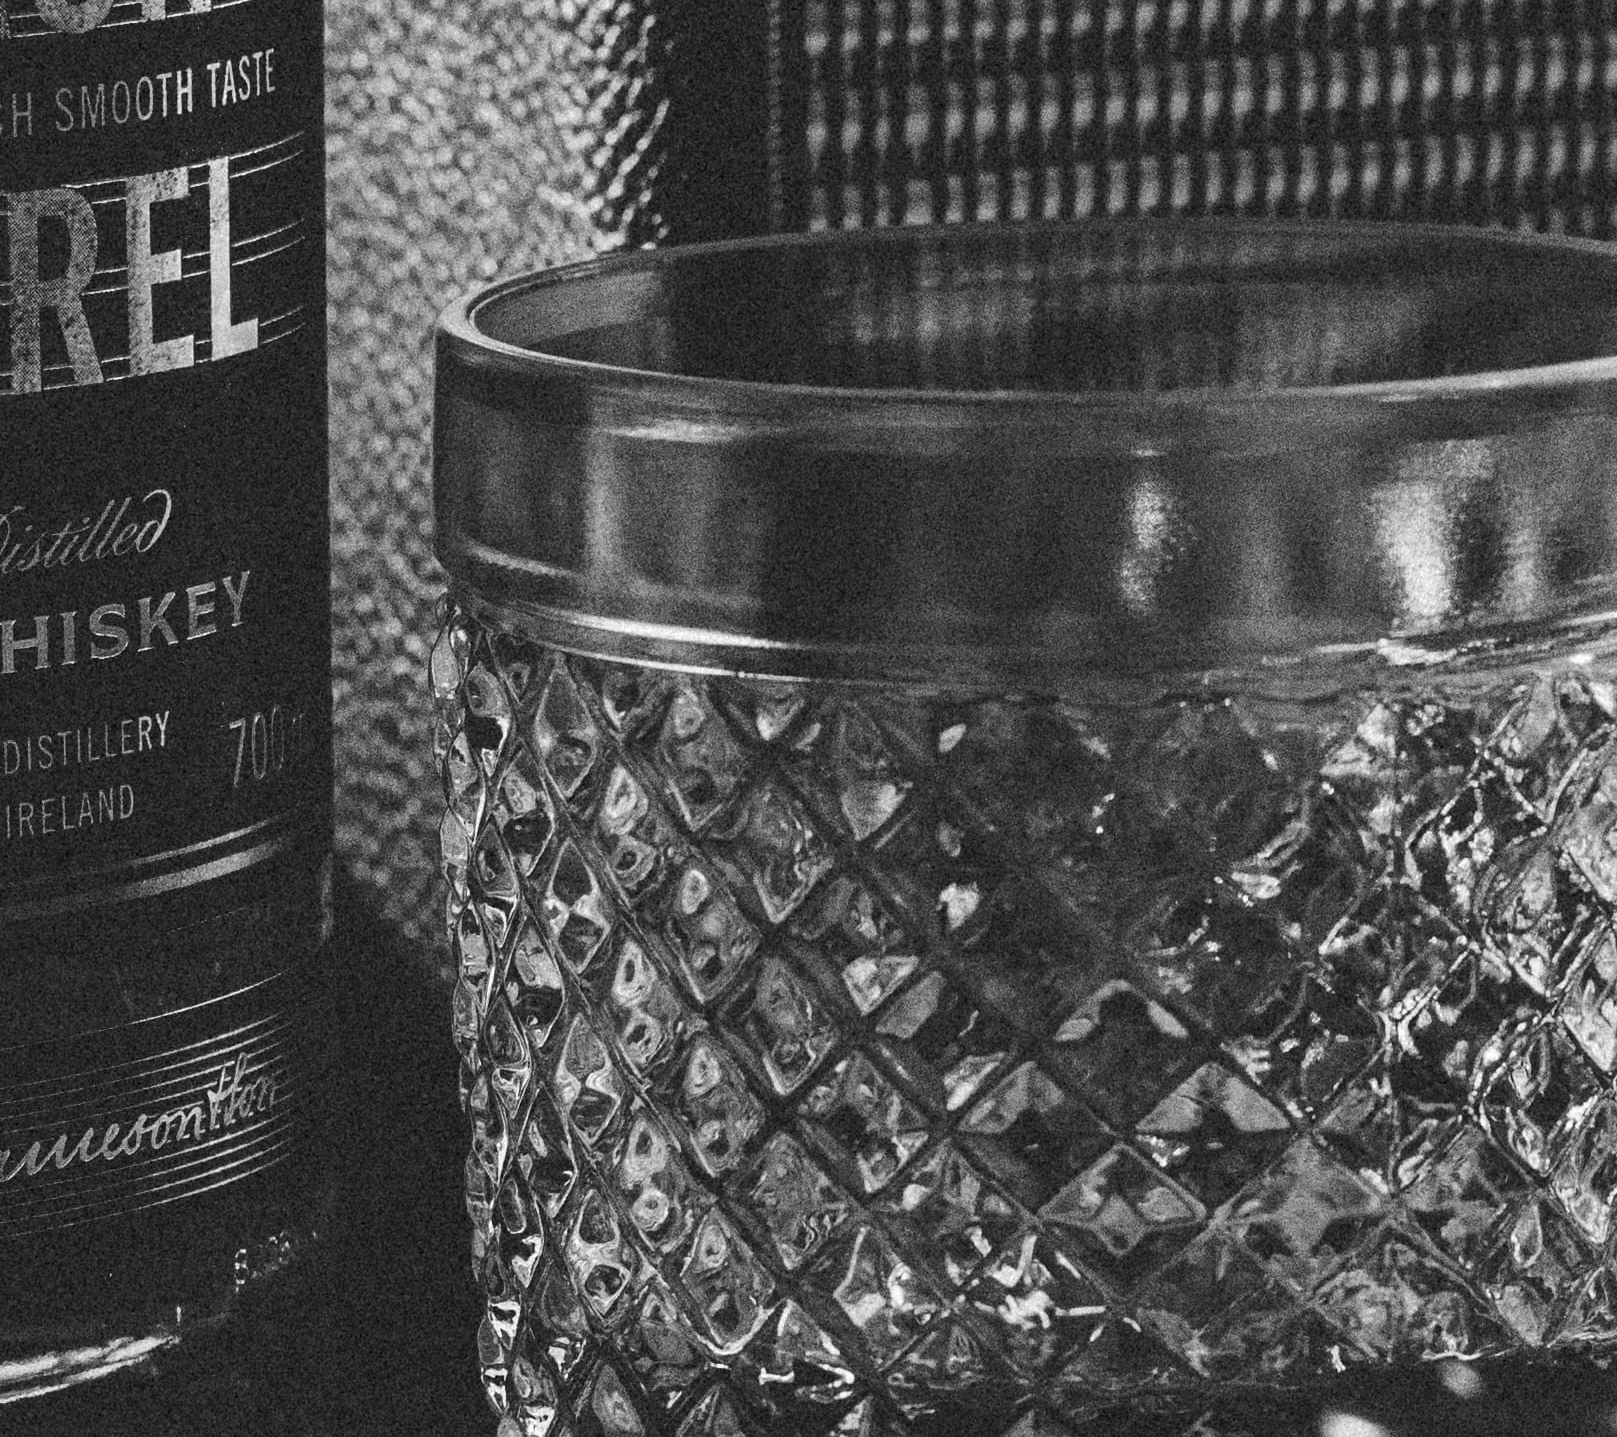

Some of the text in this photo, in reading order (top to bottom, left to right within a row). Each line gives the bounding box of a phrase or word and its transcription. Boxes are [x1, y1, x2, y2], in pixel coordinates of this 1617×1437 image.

[55, 68, 193, 132] SMOOTH
[207, 48, 277, 109] TASTE
[4, 710, 171, 776] DISTILLERY
[5, 784, 135, 839] IRELAND
